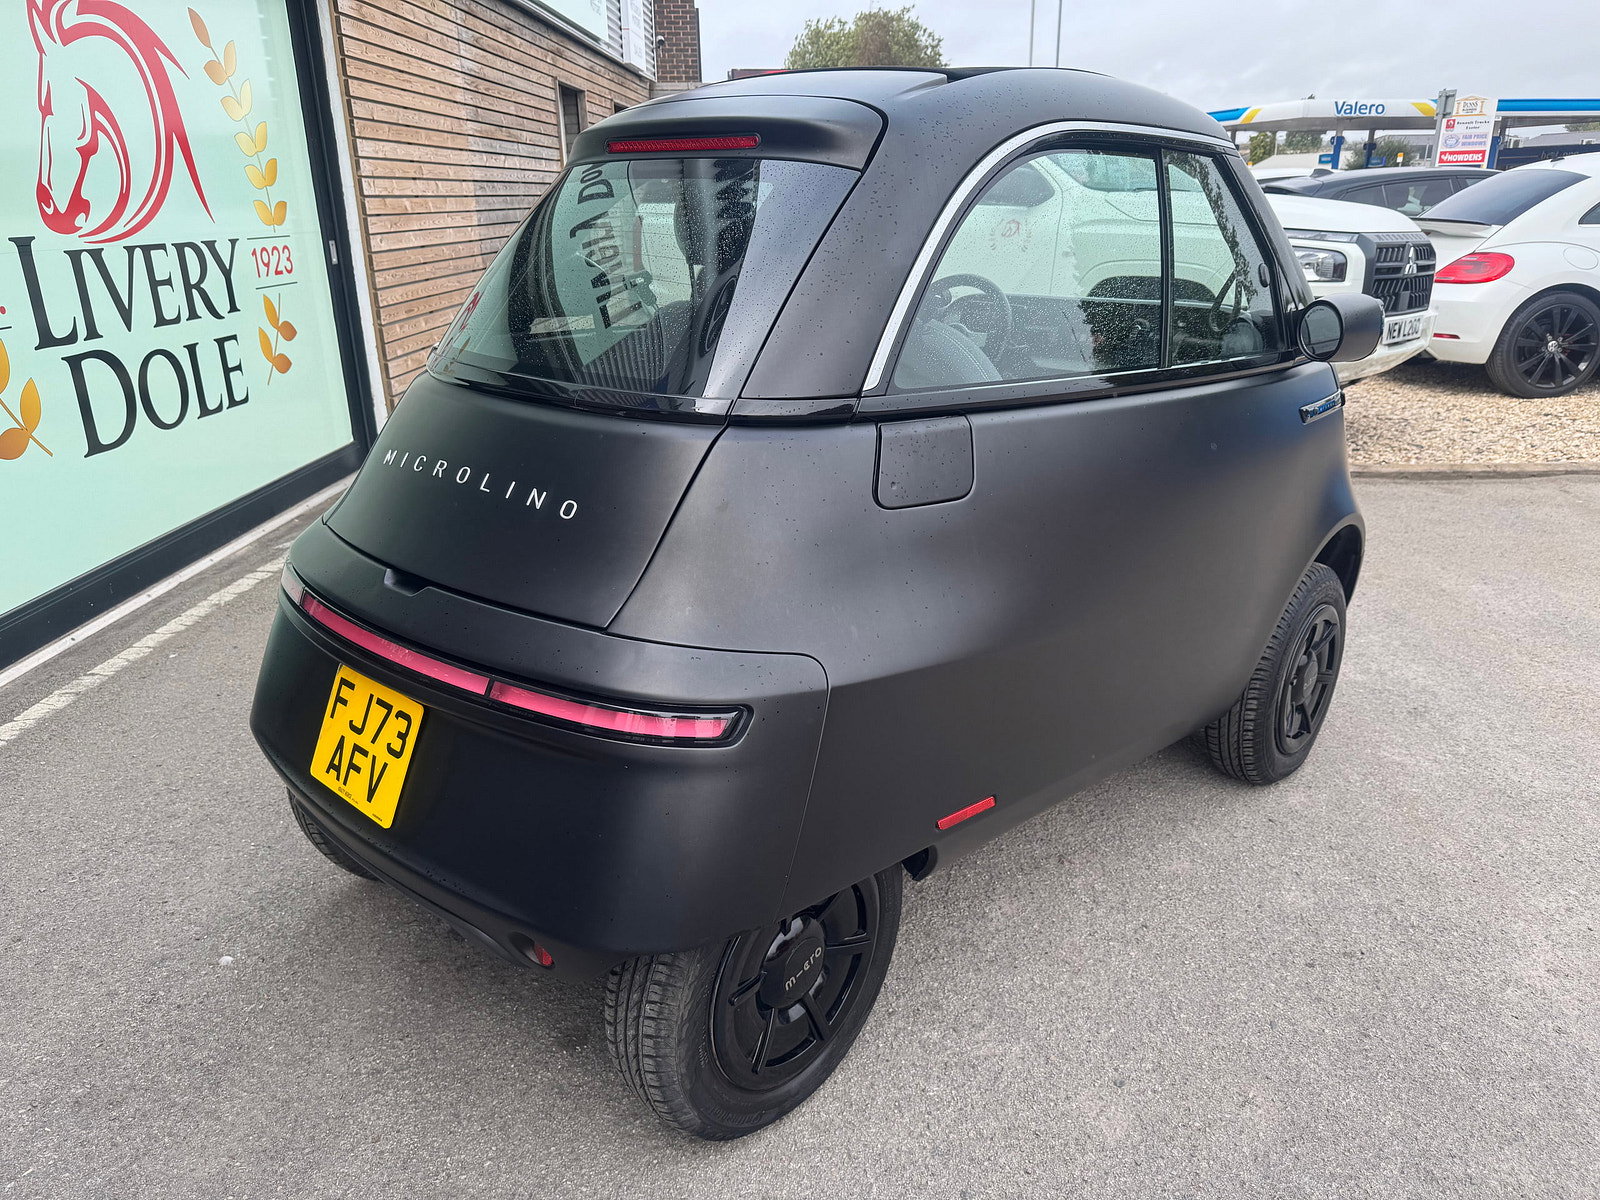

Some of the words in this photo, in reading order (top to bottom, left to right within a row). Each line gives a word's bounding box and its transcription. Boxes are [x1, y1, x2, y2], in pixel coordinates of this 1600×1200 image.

[1334, 101, 1386, 116] Valero
[1447, 153, 1483, 161] HOWDENS
[8, 236, 241, 350] LIVERY
[251, 244, 294, 278] 1923
[1386, 321, 1404, 340] NEW
[61, 334, 250, 459] DOLE
[382, 449, 578, 520] MICROLINO
[330, 677, 413, 760] FJ73
[325, 735, 389, 804] AFV
